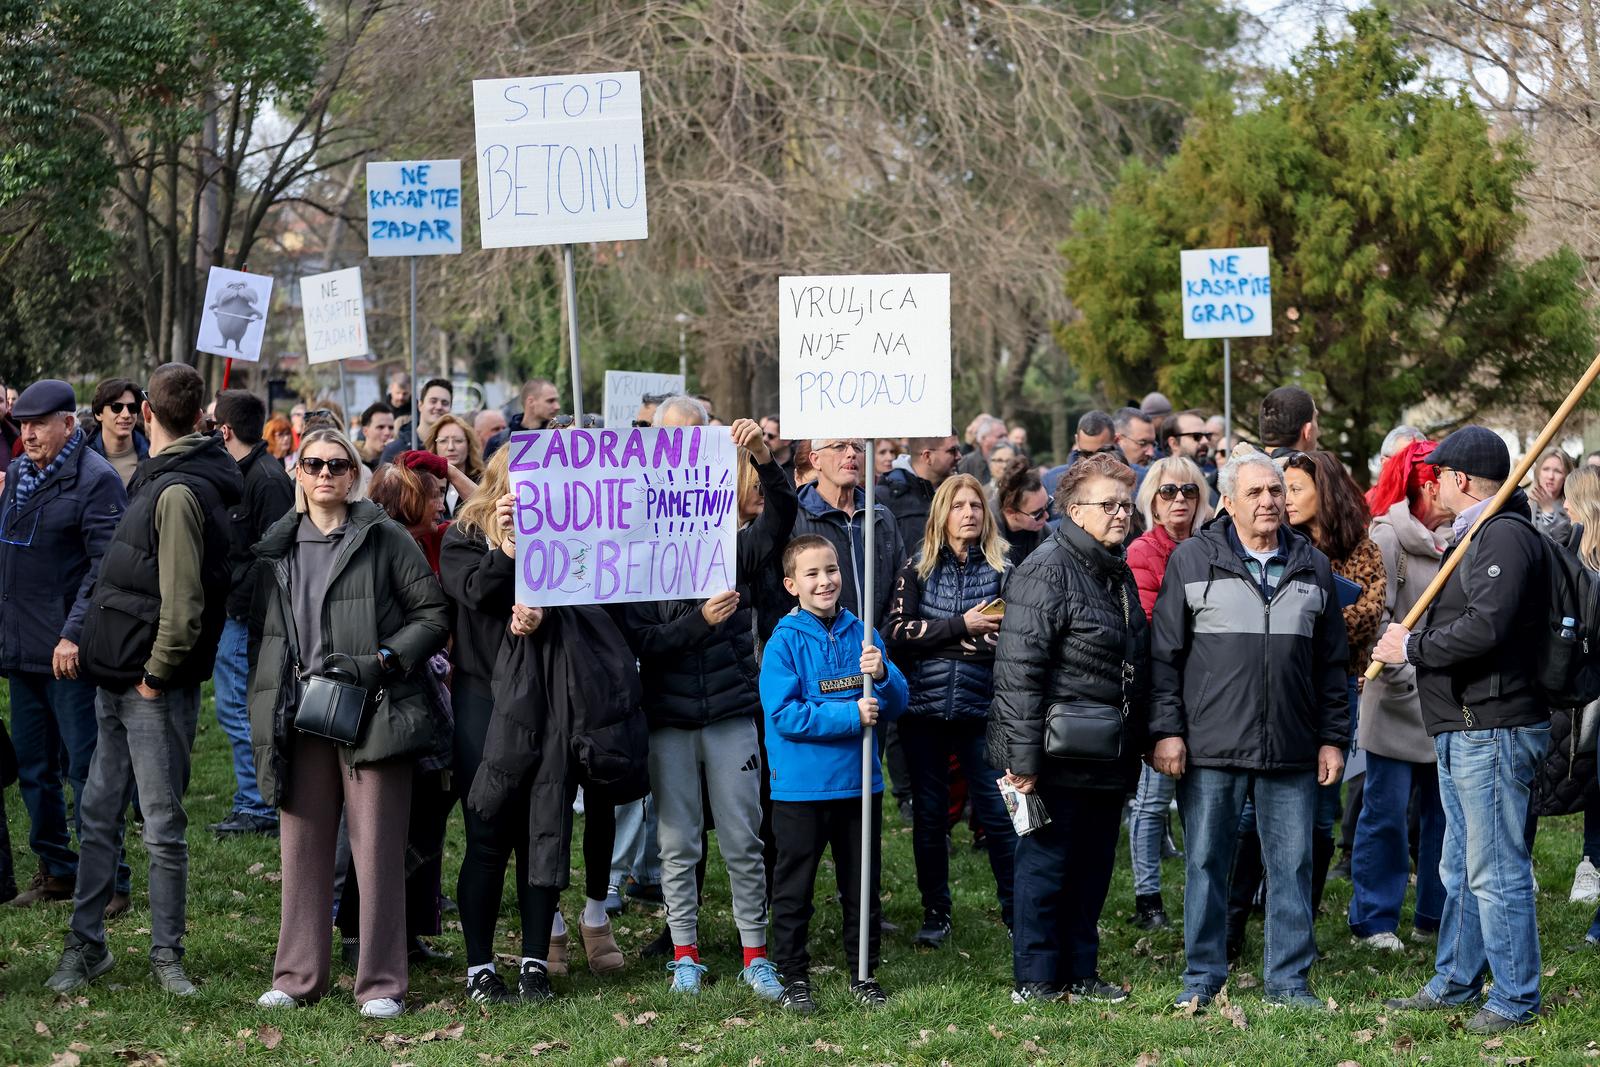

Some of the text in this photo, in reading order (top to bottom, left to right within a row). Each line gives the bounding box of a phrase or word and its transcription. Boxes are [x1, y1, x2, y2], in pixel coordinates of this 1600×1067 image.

[504, 79, 622, 122] STOP
[400, 165, 431, 186] NE
[482, 143, 639, 221] BETONU
[369, 188, 460, 210] KASAPITE
[372, 219, 455, 243] ZADAR
[1209, 255, 1240, 276] NE
[321, 279, 340, 299] NE
[1191, 303, 1255, 324] GRAD
[800, 328, 911, 361] NIJE NA
[795, 370, 926, 412] PRODAJU
[508, 426, 702, 473] ZADRANI
[515, 478, 637, 536] BUDITE
[523, 538, 732, 600] OD BETONA
